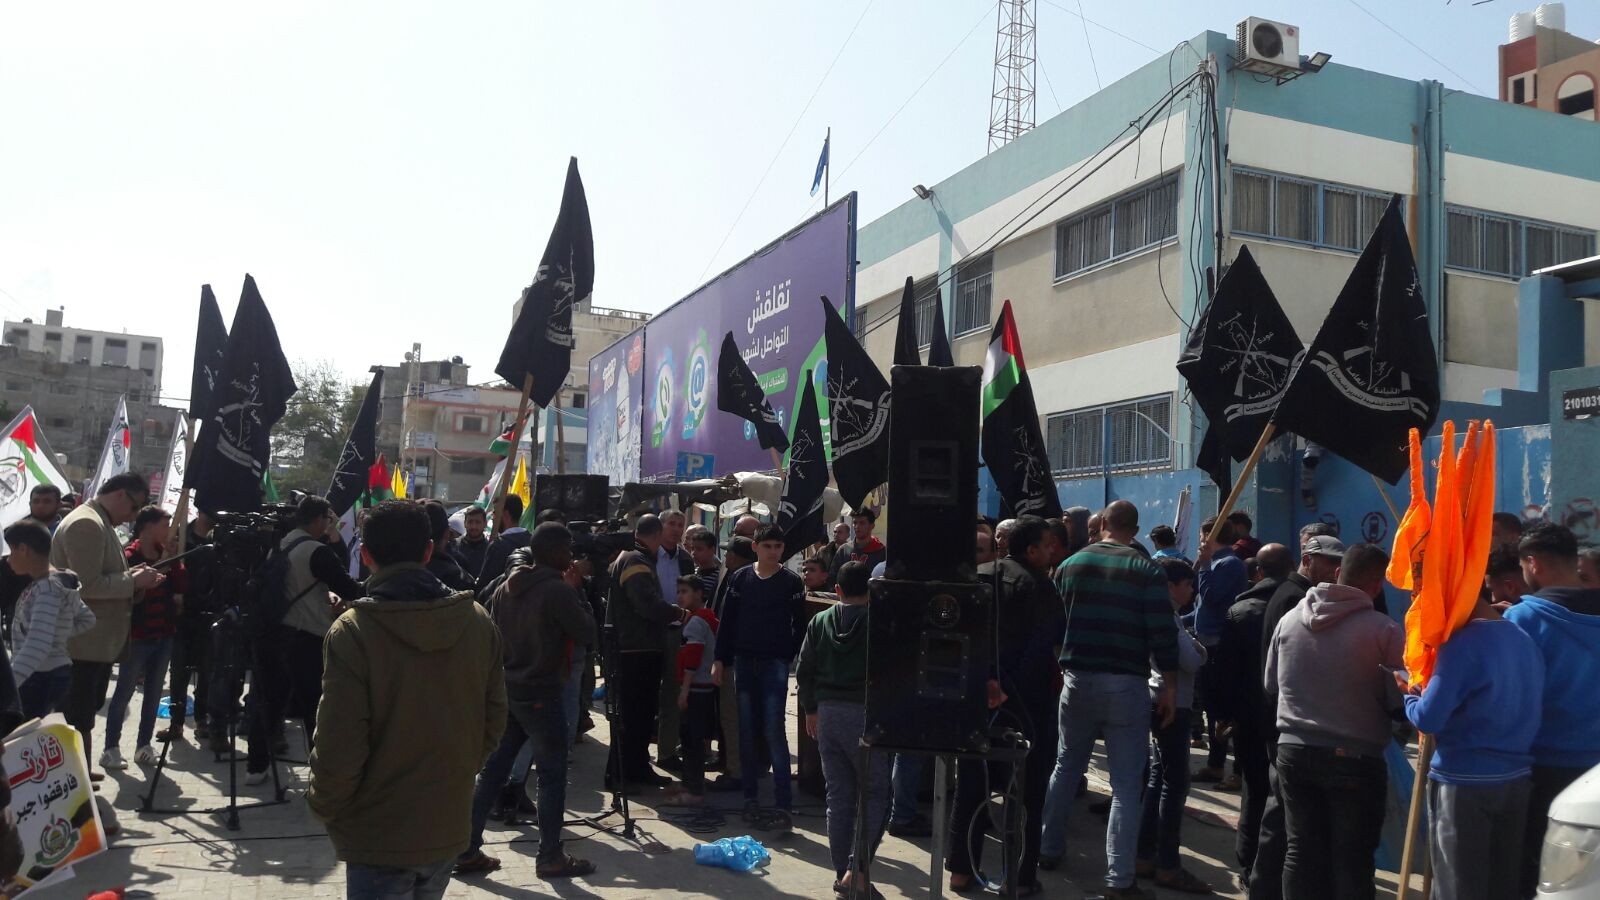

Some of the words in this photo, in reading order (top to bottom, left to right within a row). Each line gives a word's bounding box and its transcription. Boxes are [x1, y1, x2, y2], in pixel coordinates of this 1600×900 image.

[760, 326, 789, 359] التواصل
[687, 453, 705, 474] P
[9, 734, 64, 789] ثأرن
